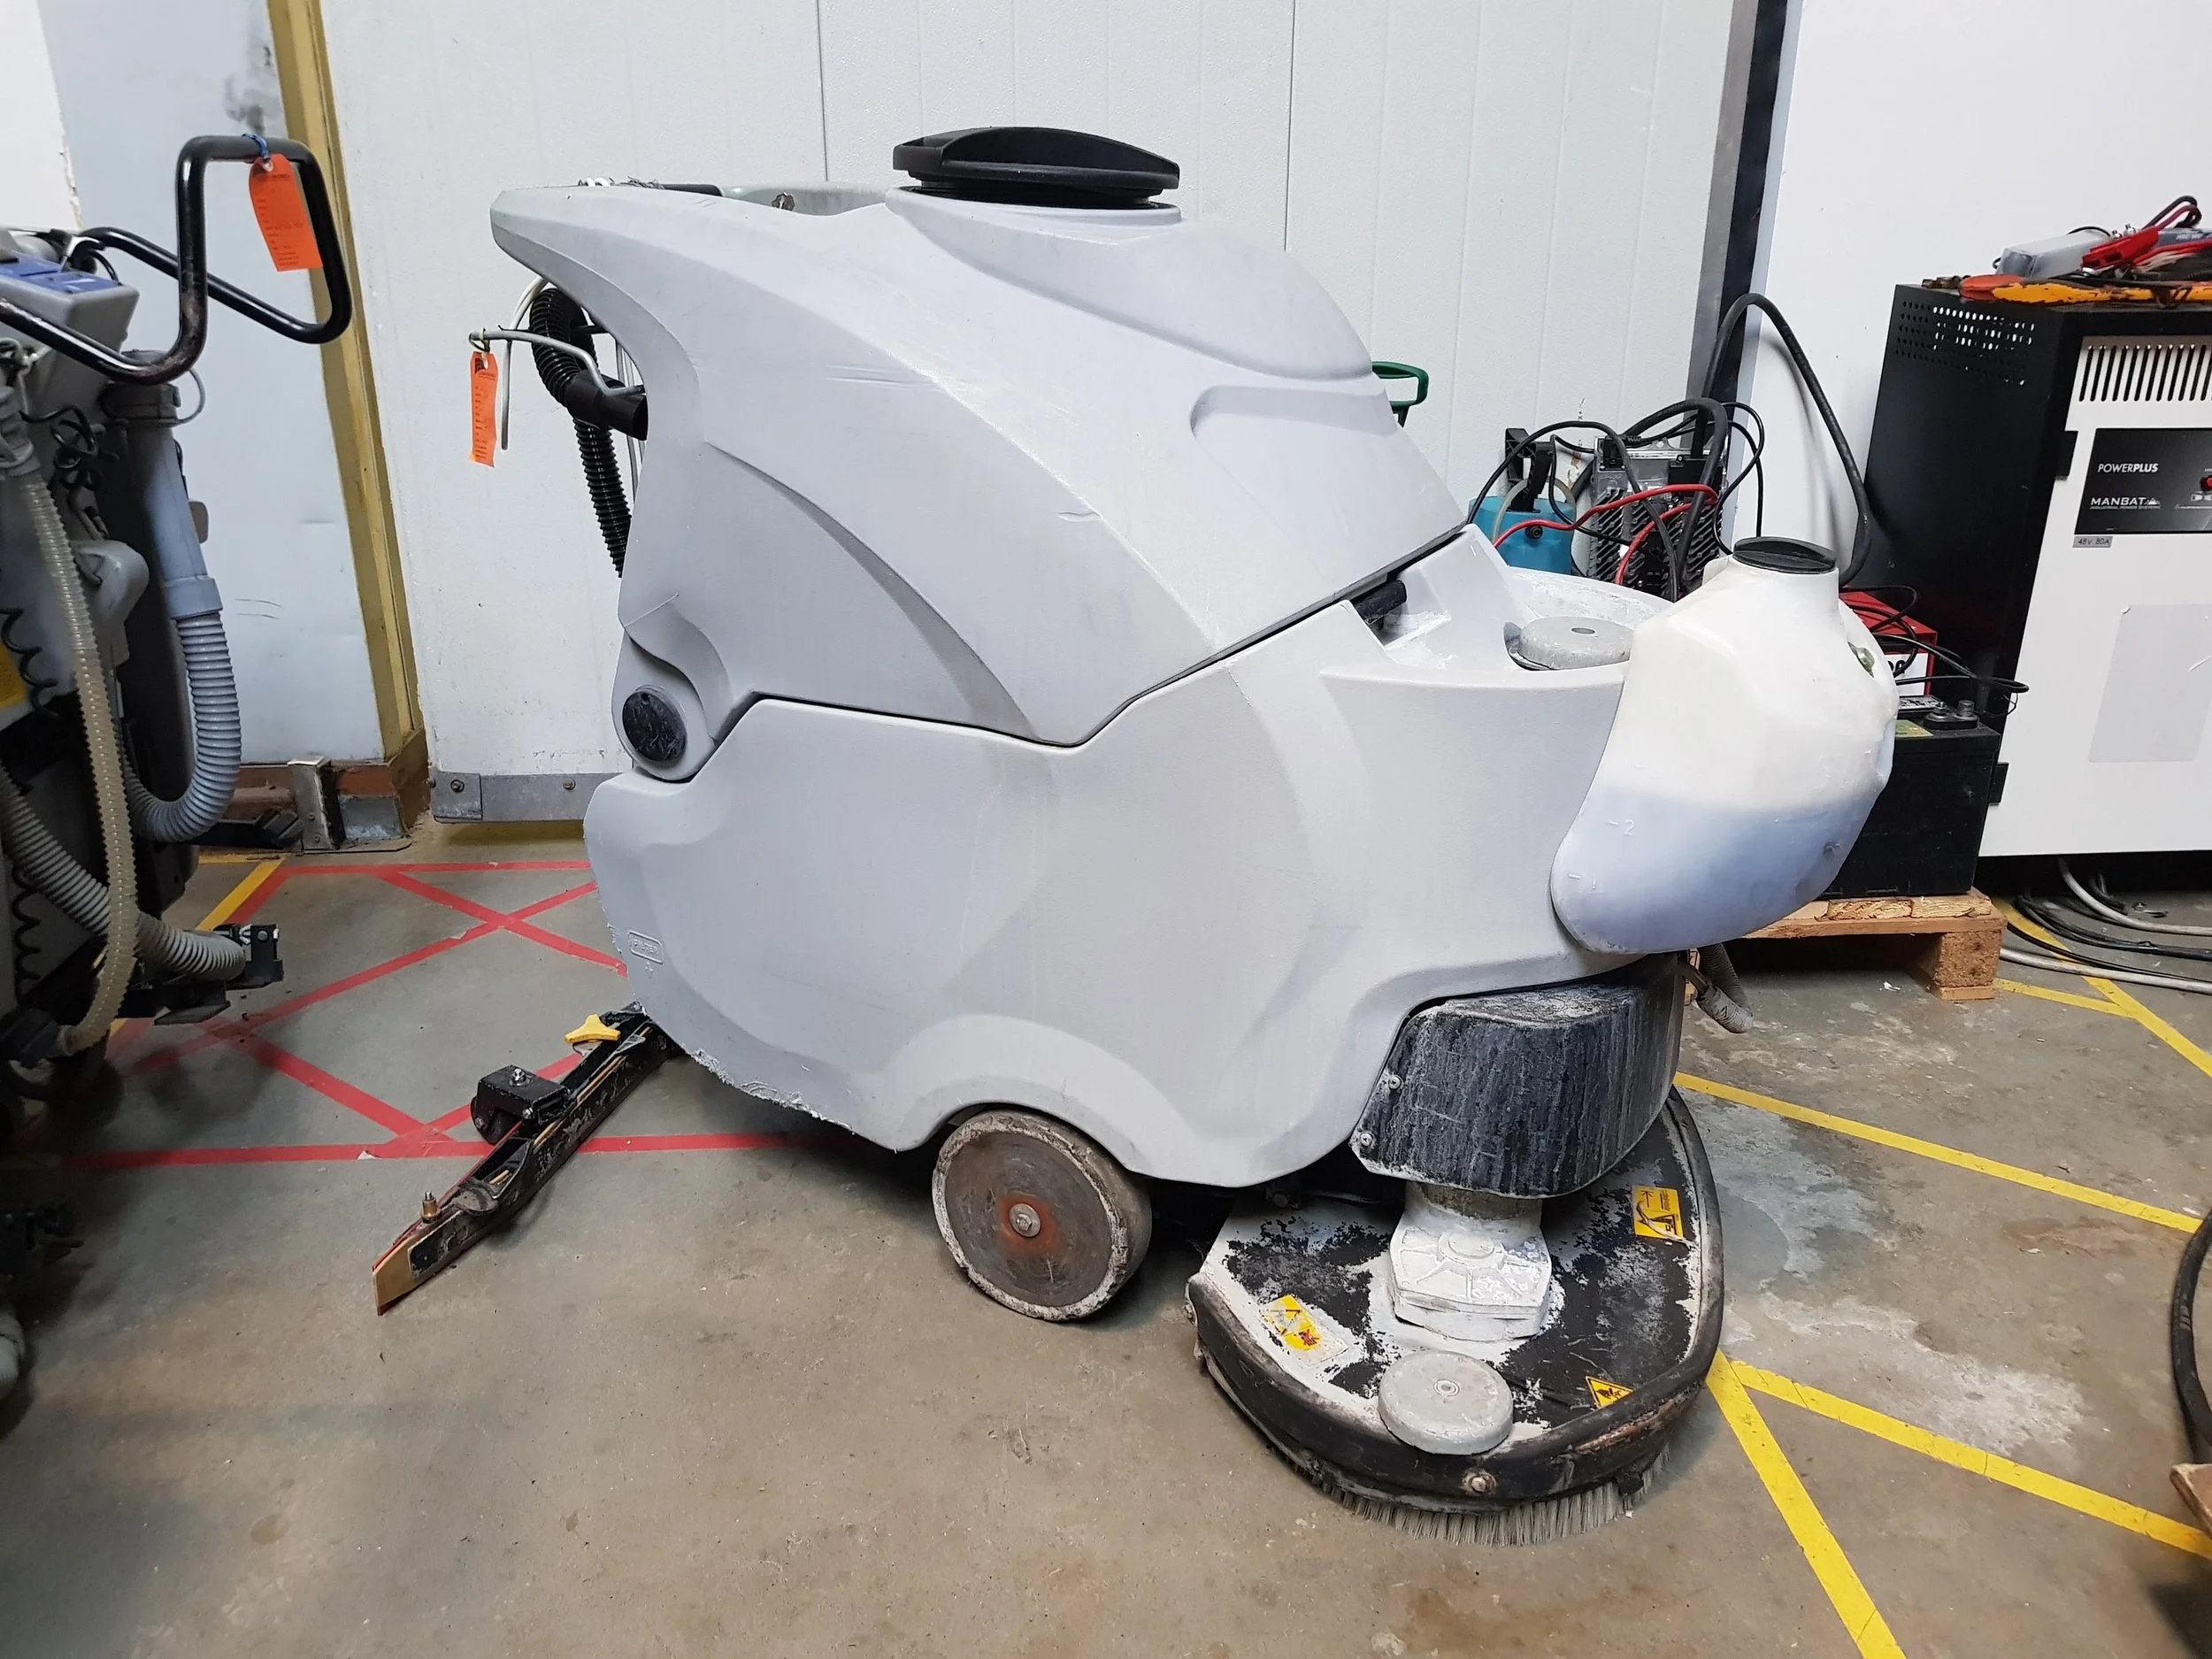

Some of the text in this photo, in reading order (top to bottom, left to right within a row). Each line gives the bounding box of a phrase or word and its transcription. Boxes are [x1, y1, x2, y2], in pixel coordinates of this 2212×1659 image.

[2097, 463, 2159, 473] POWERPLUS
[2090, 497, 2147, 506] MANBAT
[1623, 818, 1635, 836] 2
